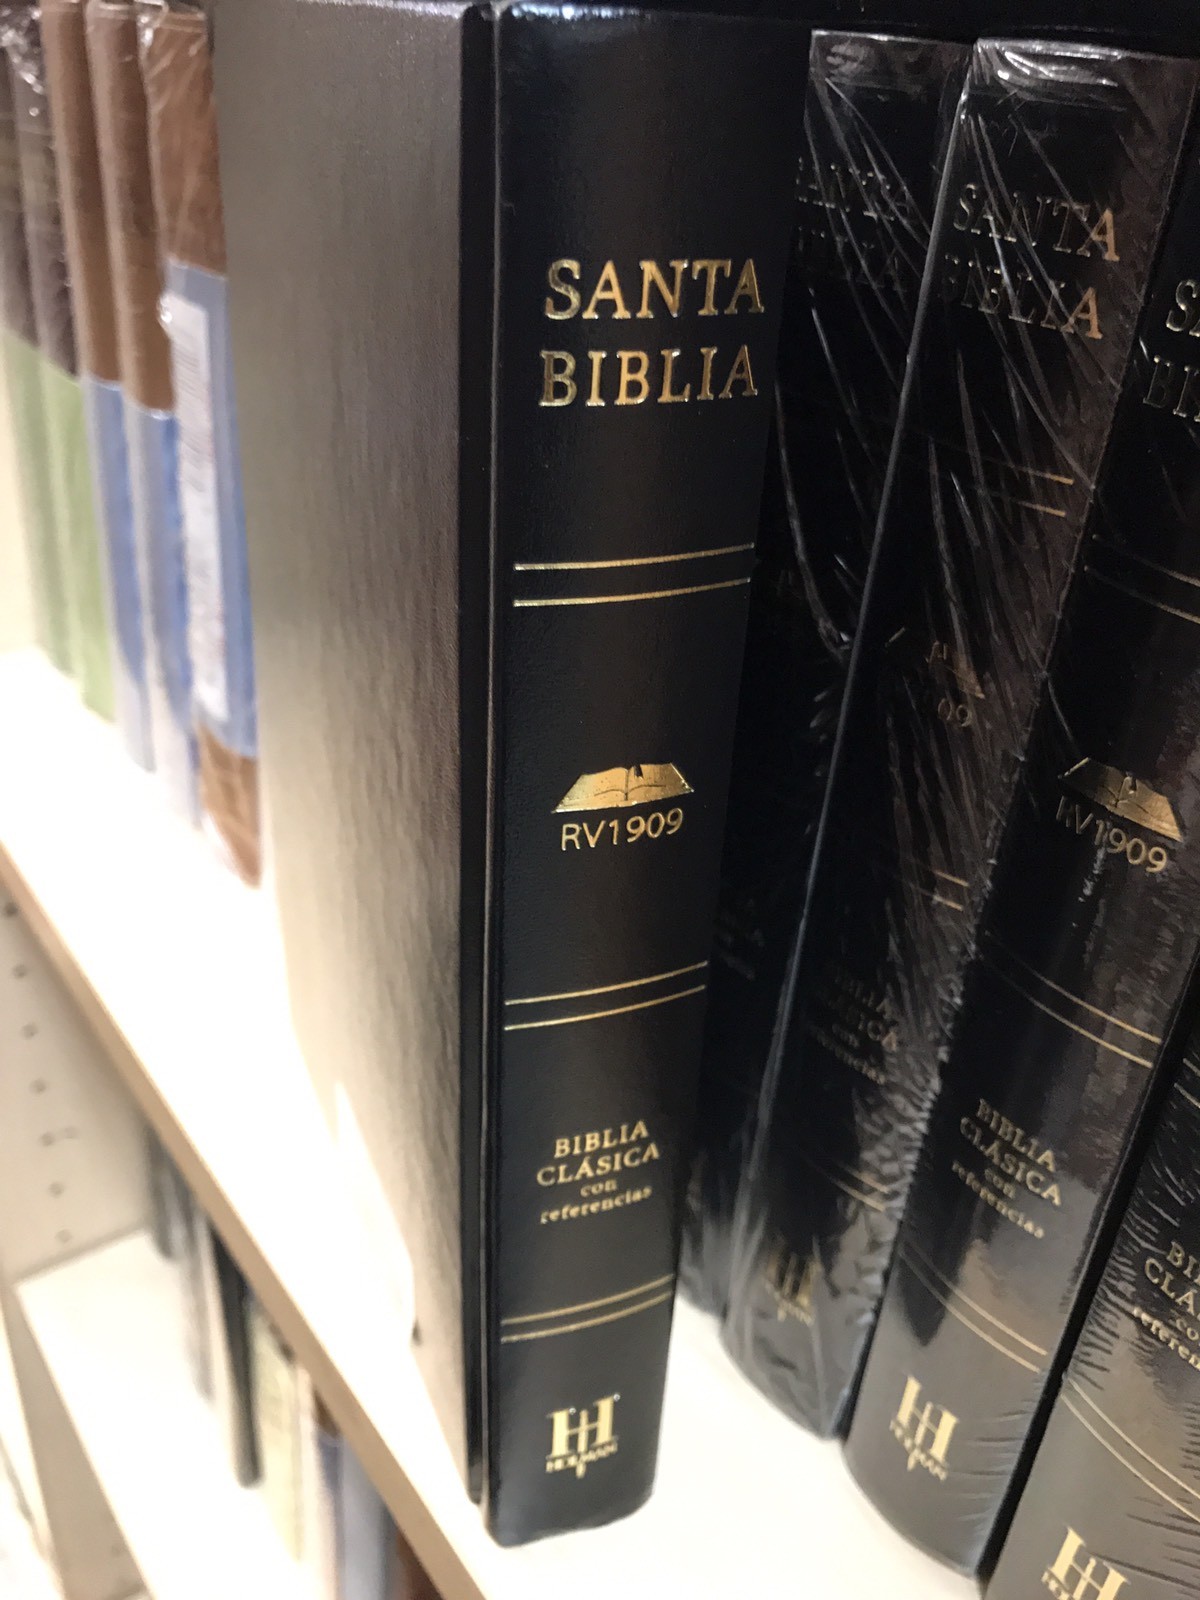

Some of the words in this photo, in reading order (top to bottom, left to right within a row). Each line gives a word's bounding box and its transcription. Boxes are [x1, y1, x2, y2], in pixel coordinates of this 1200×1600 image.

[544, 258, 765, 321] SANTA
[538, 344, 759, 407] BIBLIA
[1143, 354, 1200, 422] BI
[560, 807, 684, 851] RV1909
[553, 1119, 649, 1159] BIBLIA
[976, 1098, 1057, 1173] BIBLIA
[536, 1142, 661, 1187] CLÁSICA
[540, 1186, 653, 1225] referencias
[580, 1178, 618, 1198] con
[1166, 1240, 1200, 1285] BI
